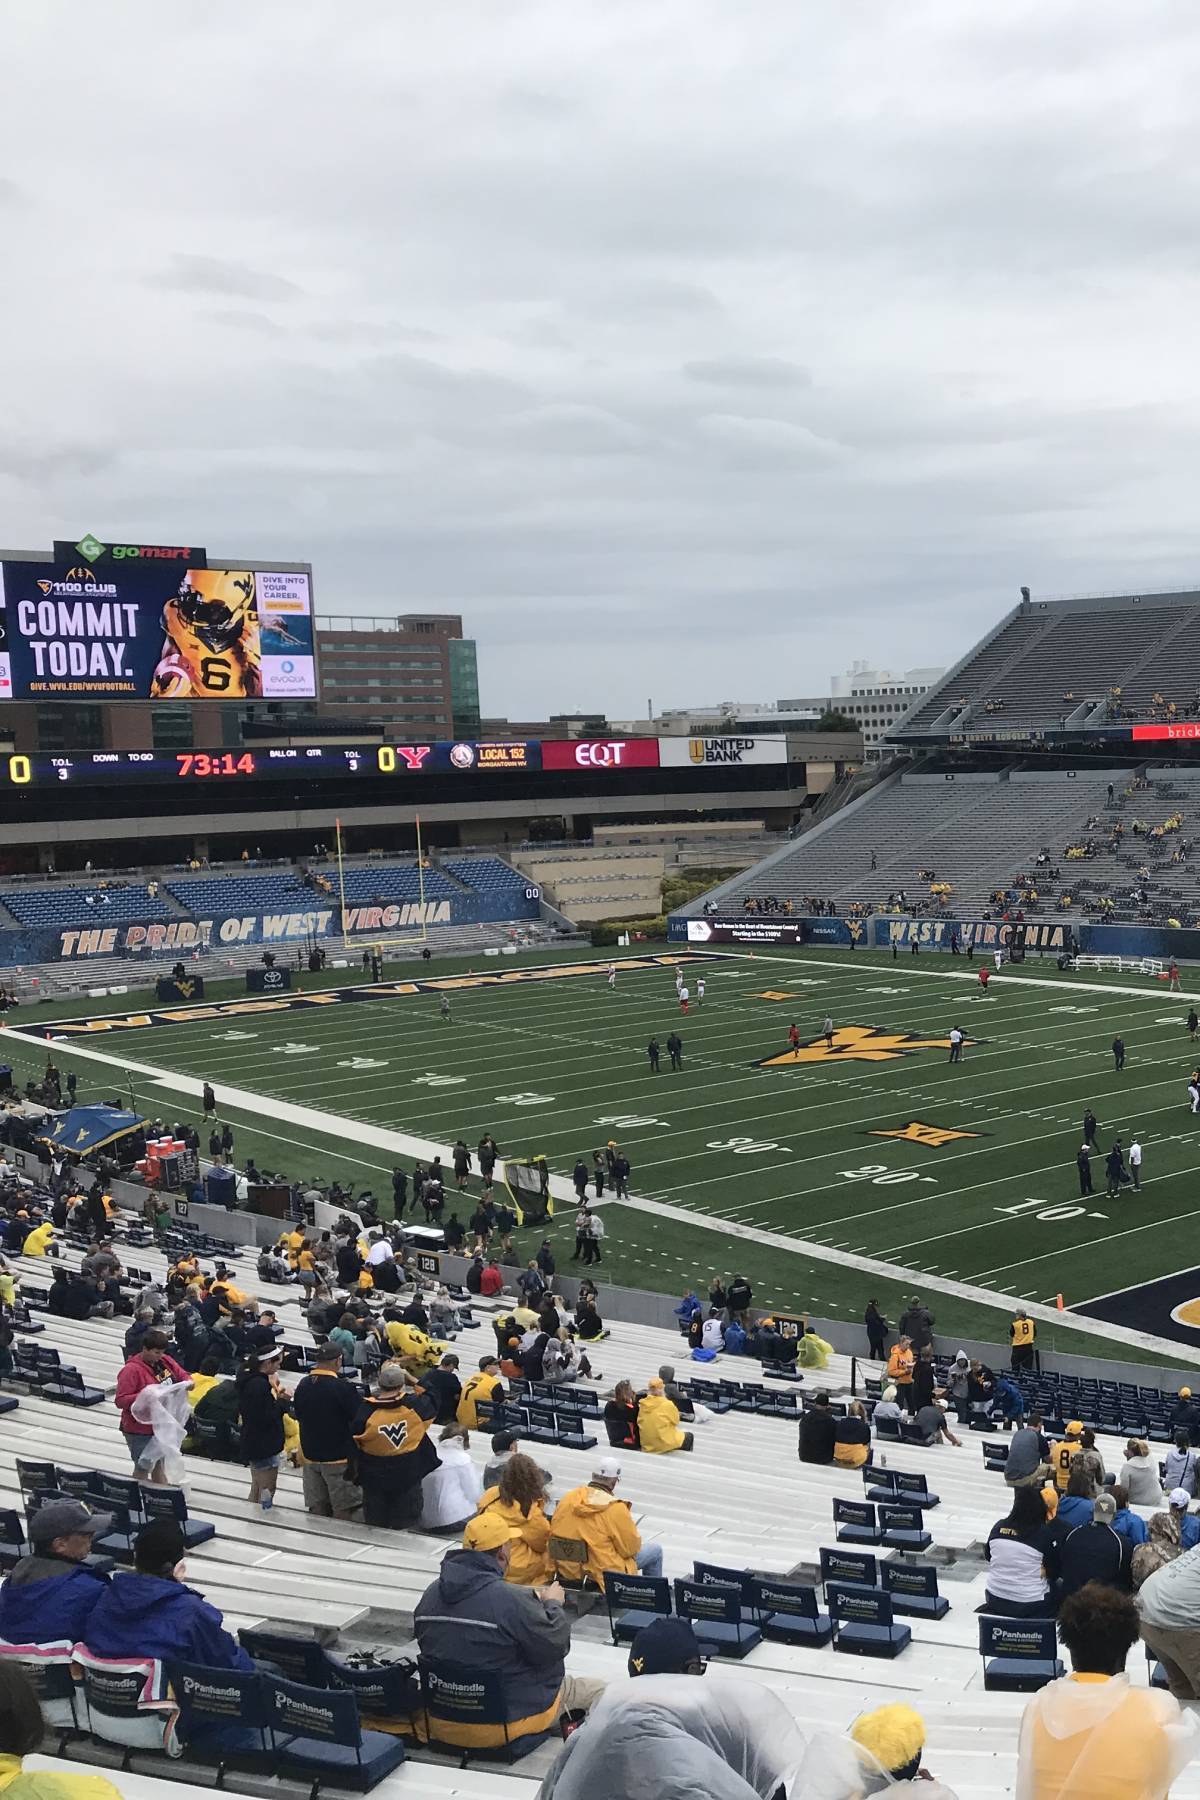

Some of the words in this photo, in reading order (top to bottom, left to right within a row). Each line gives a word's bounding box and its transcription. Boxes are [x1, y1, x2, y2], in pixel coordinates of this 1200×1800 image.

[112, 546, 190, 559] gomart
[85, 584, 117, 593] CLUB
[17, 600, 139, 637] COMMIT
[29, 641, 134, 677] TODAY.
[705, 738, 754, 750] UNITED
[93, 754, 118, 762] DOWN
[378, 746, 395, 771] 0
[397, 747, 430, 768] Y
[479, 748, 509, 760] LOCAL
[509, 748, 525, 759] 152
[575, 742, 626, 766] EQT
[705, 750, 743, 762] BANK
[9, 756, 31, 783] 0
[176, 753, 255, 776] 73:14
[349, 760, 358, 770] 3
[58, 768, 68, 780] 3
[60, 928, 118, 956] THE
[126, 920, 214, 950] PRIDE
[219, 916, 257, 942] OF
[262, 911, 333, 937] WEST
[341, 901, 451, 931] VIRGINIA
[889, 921, 945, 942] WEST
[706, 1137, 779, 1154] 30
[835, 1165, 921, 1185] 20
[993, 1198, 1087, 1221] 10
[422, 1259, 435, 1272] 128
[1021, 1323, 1029, 1335] 8
[464, 1382, 479, 1400] 7
[1059, 1449, 1070, 1469] 8
[843, 1597, 879, 1607] Panhandle
[1002, 1630, 1043, 1640] Panhandle
[194, 1682, 241, 1697] Panhandle
[438, 1679, 485, 1692] Panhandle
[287, 1697, 334, 1718] Panhandle
